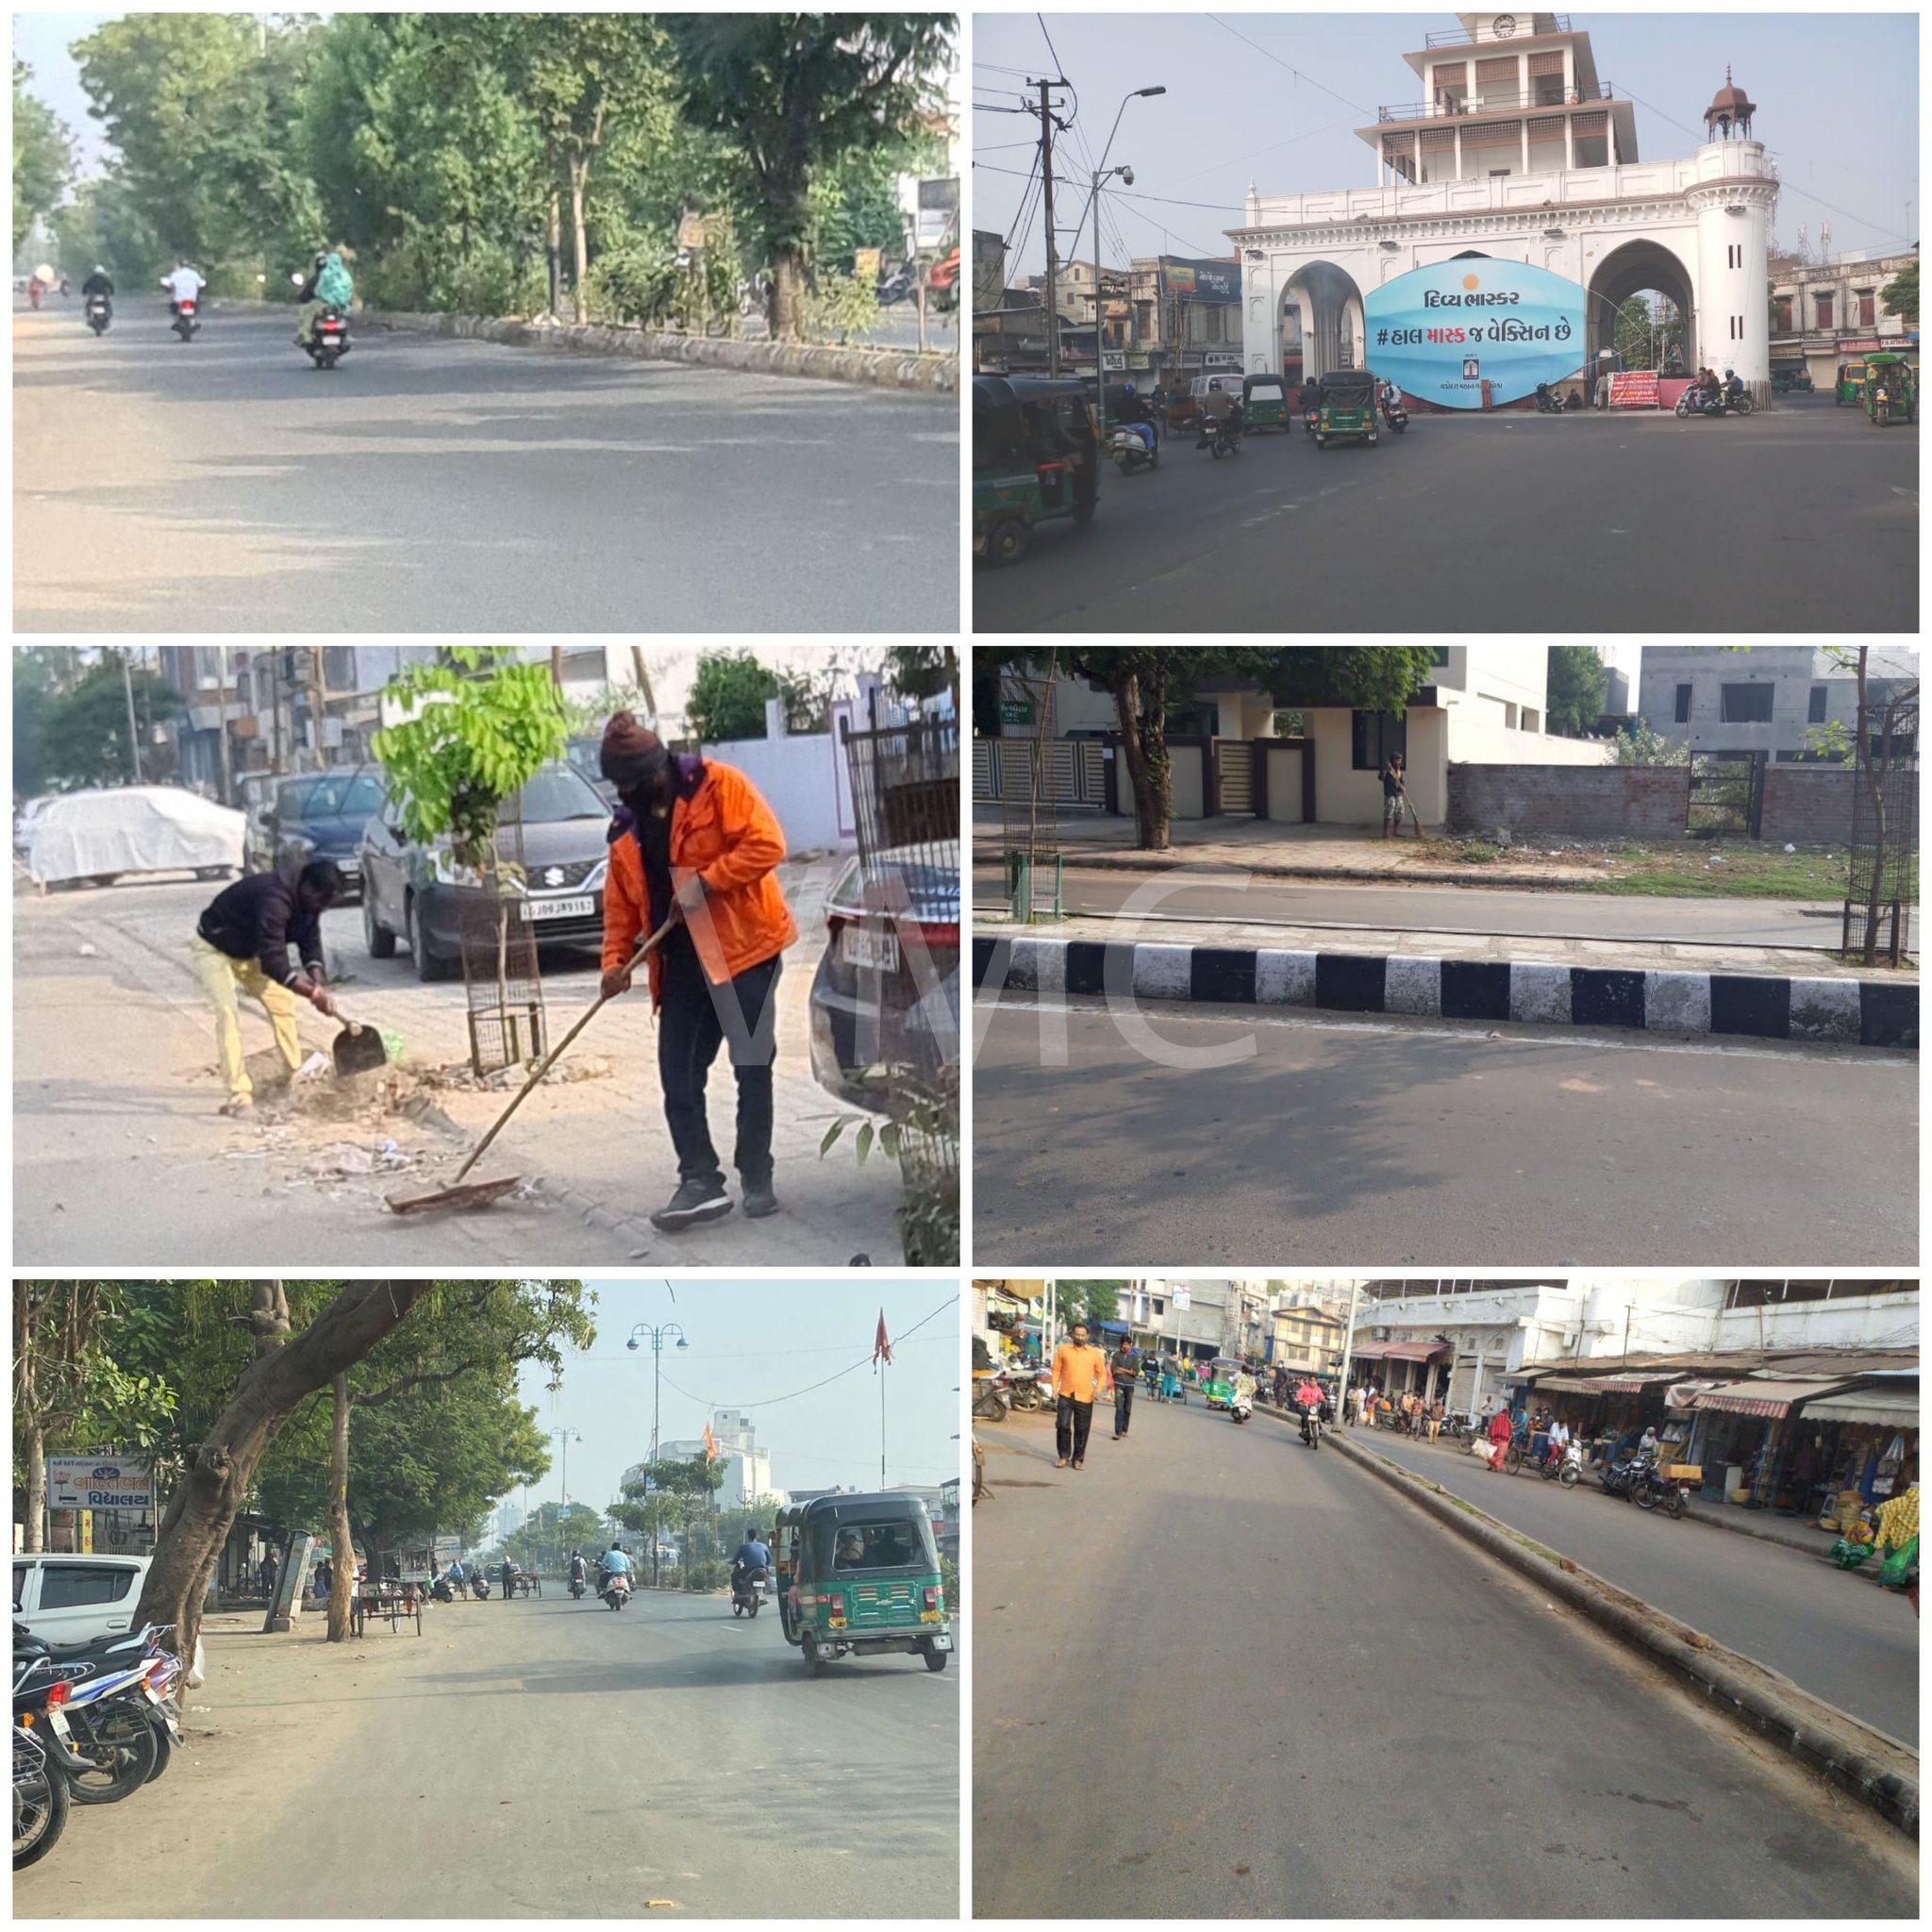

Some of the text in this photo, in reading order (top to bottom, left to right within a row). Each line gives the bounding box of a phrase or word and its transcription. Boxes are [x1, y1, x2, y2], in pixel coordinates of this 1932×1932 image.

[1424, 290, 1520, 308] દિવ્ય ભાસ્કર
[1426, 327, 1465, 343] માસ્ક
[1469, 327, 1484, 342] જ
[1488, 318, 1550, 342] વેક્સિન
[1555, 316, 1572, 341] છે
